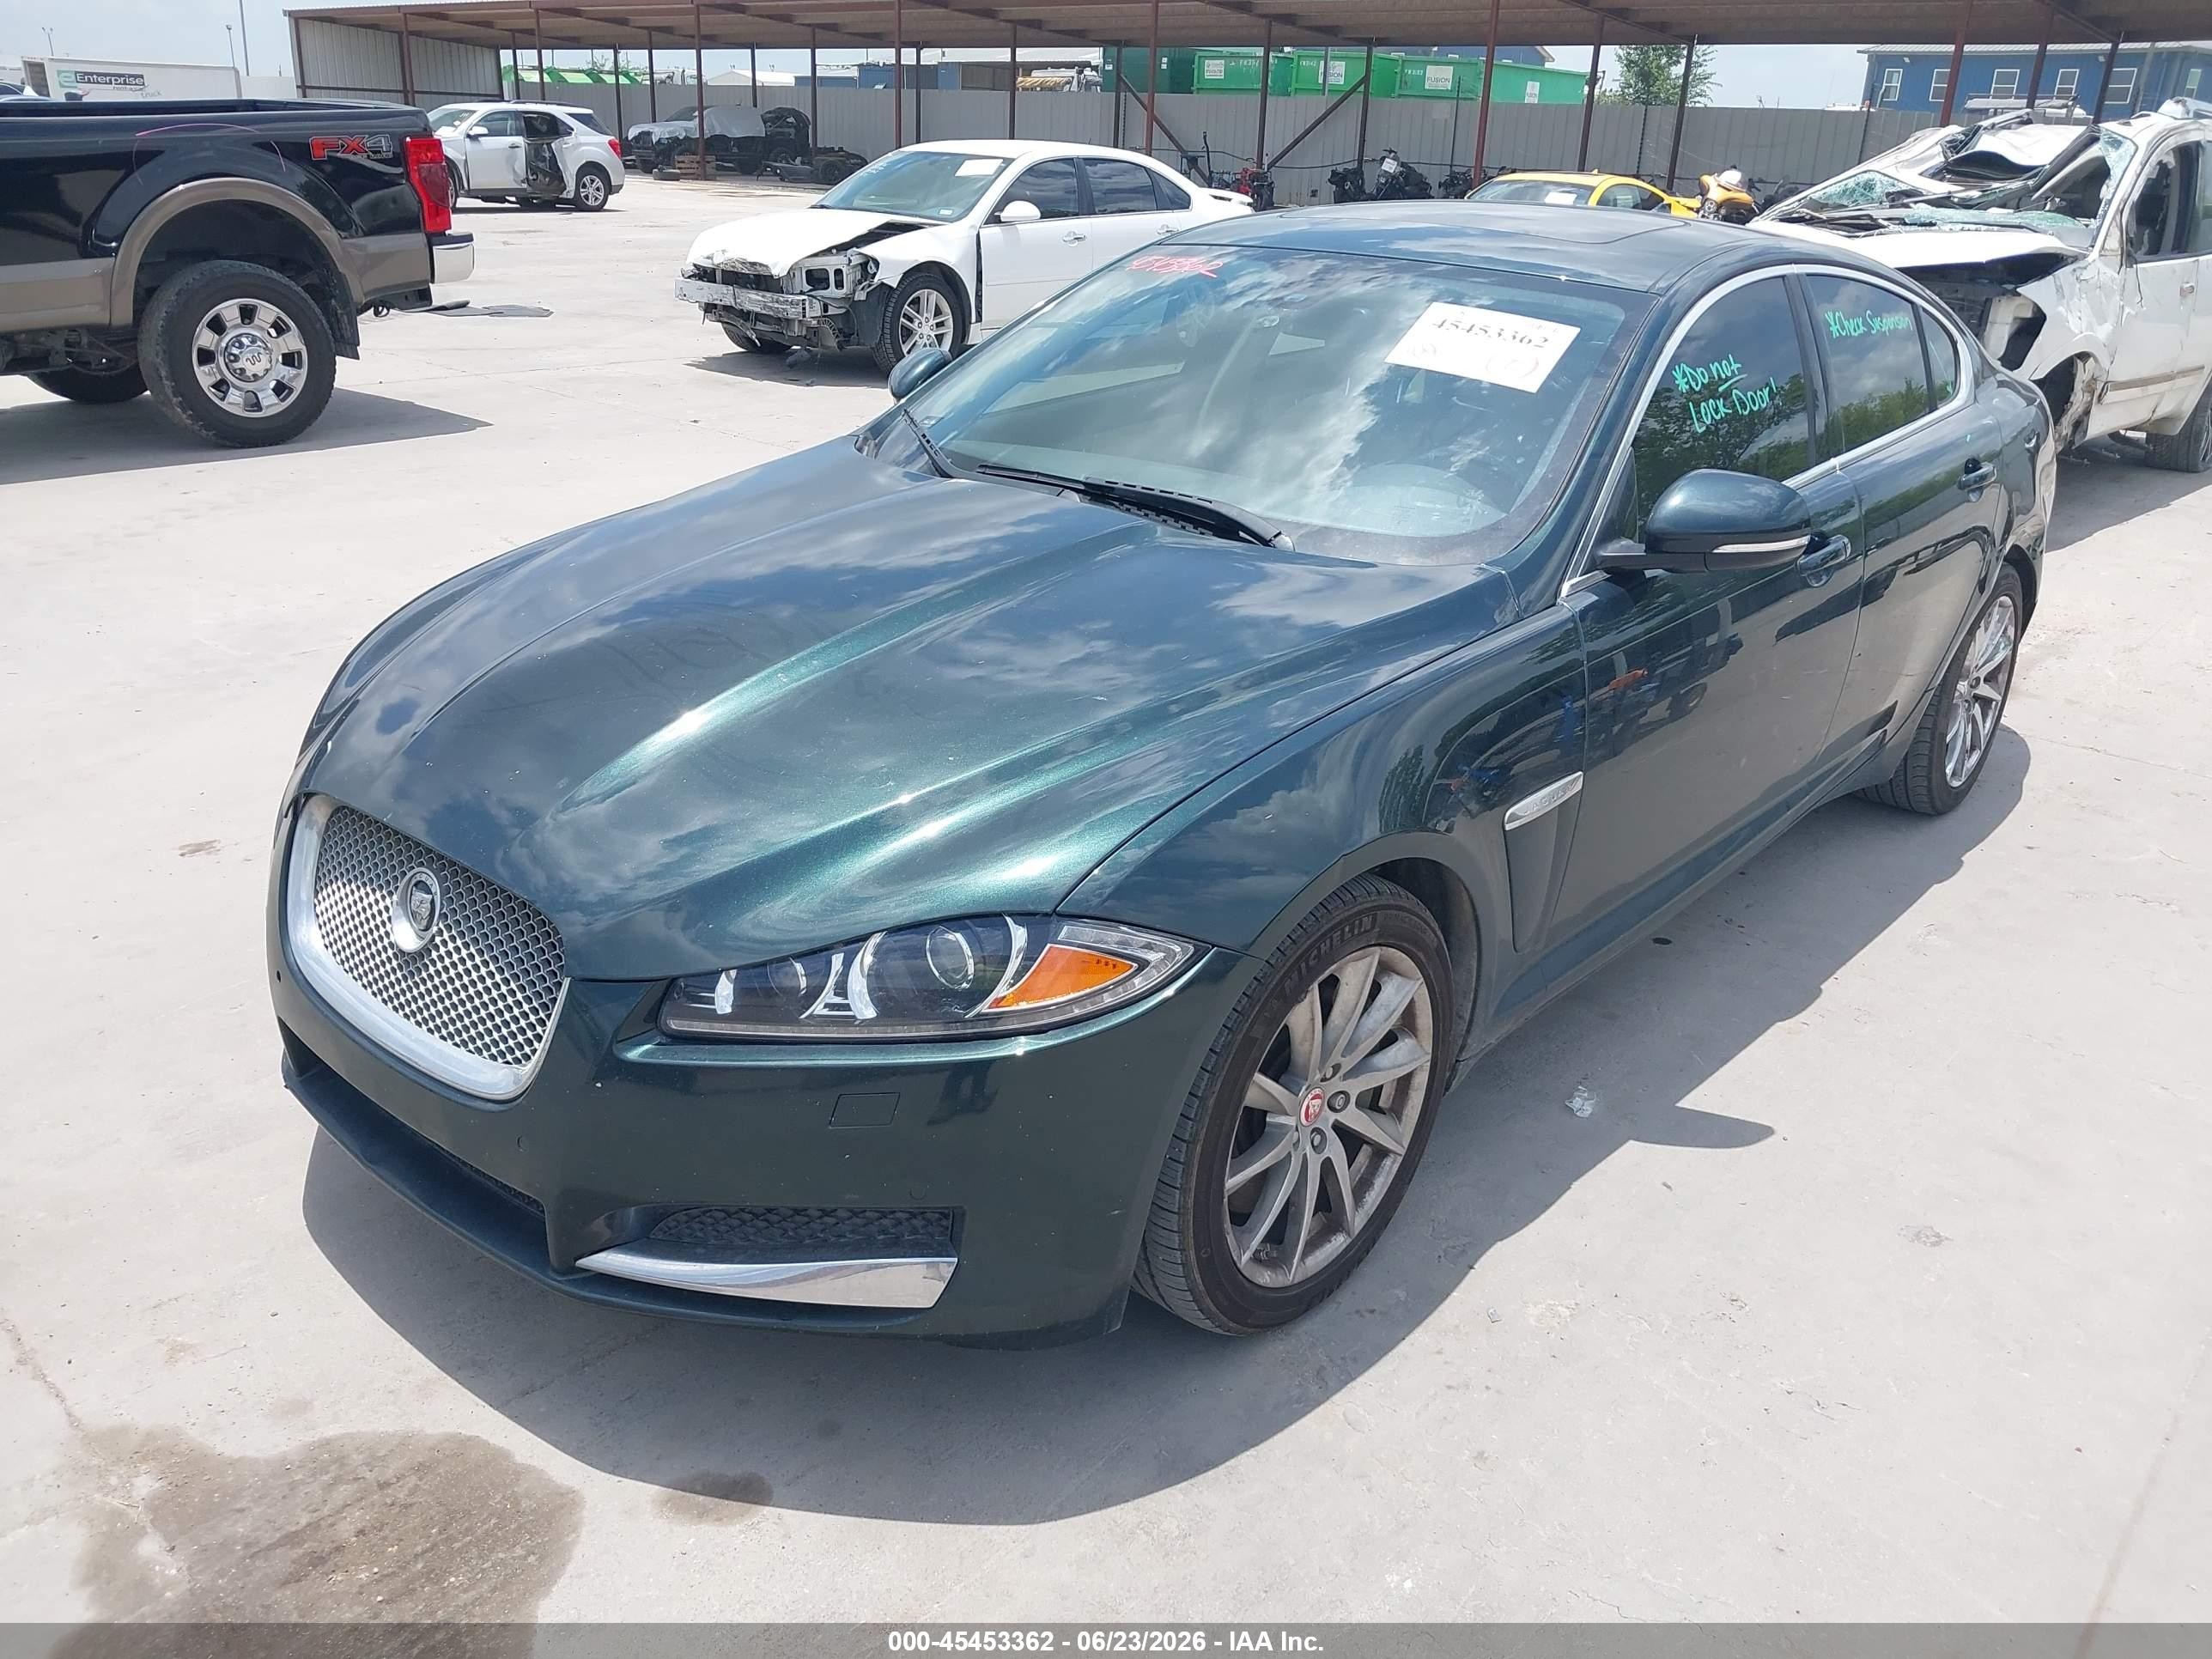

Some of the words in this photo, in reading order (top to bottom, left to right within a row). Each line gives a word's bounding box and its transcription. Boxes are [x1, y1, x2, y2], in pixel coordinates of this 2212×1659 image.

[76, 73, 143, 85] Enterprise
[309, 134, 392, 161] FX4
[1286, 913, 1377, 986] MICHELIN
